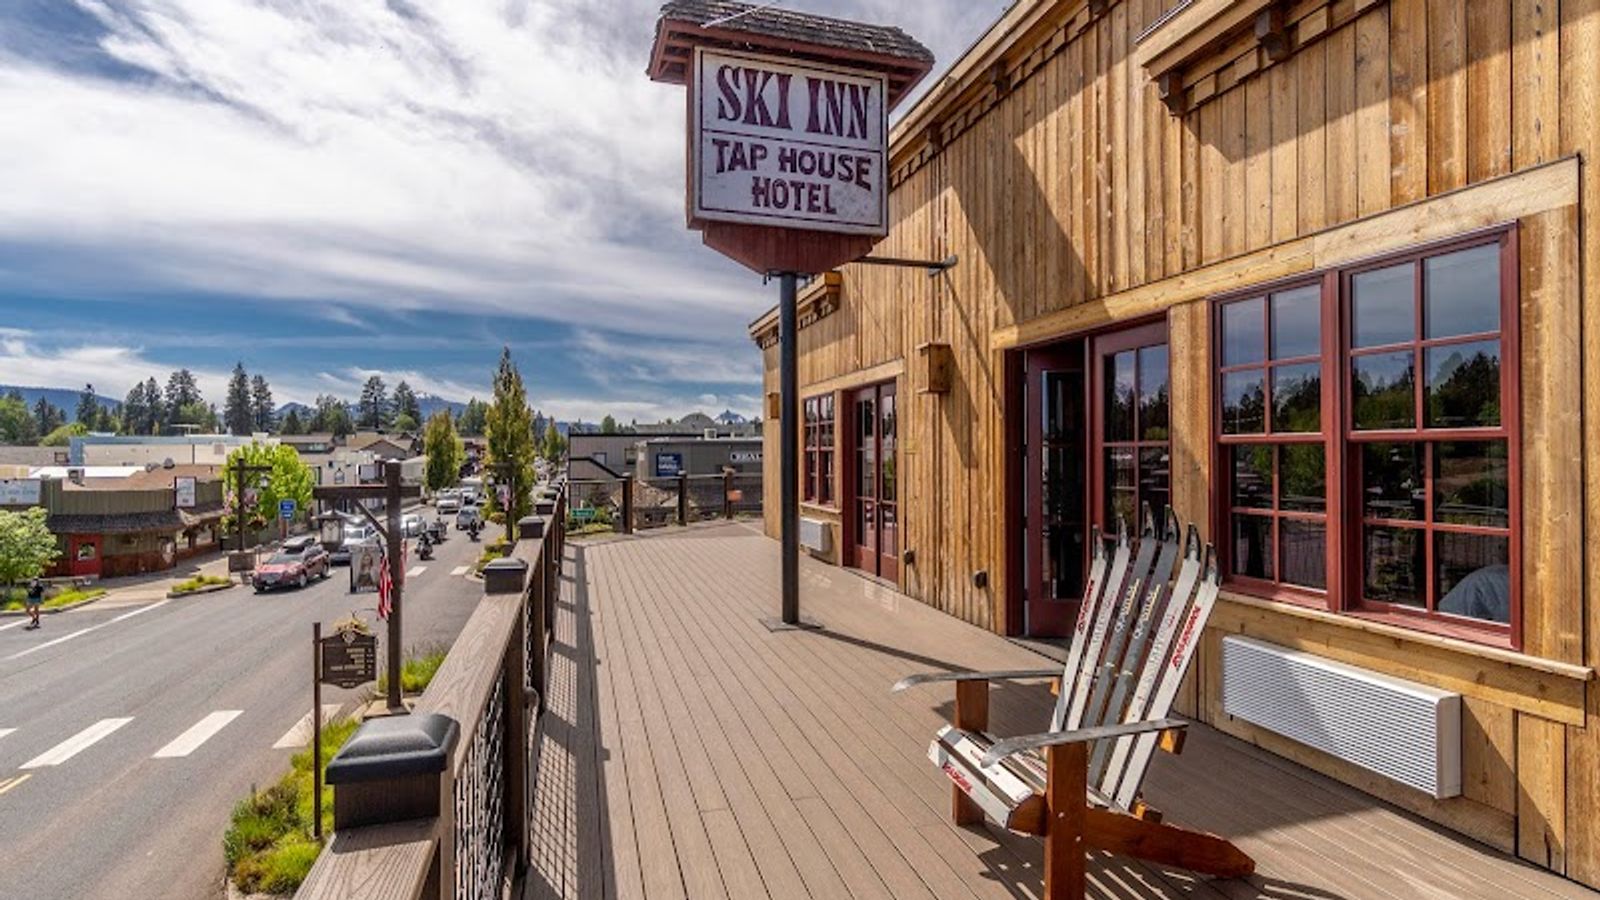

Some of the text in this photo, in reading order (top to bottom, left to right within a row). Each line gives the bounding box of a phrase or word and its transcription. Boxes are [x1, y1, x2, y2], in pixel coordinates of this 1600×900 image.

[716, 64, 871, 140] SKI INN
[712, 138, 872, 192] TAP HOUSE
[751, 176, 837, 215] HOTEL
